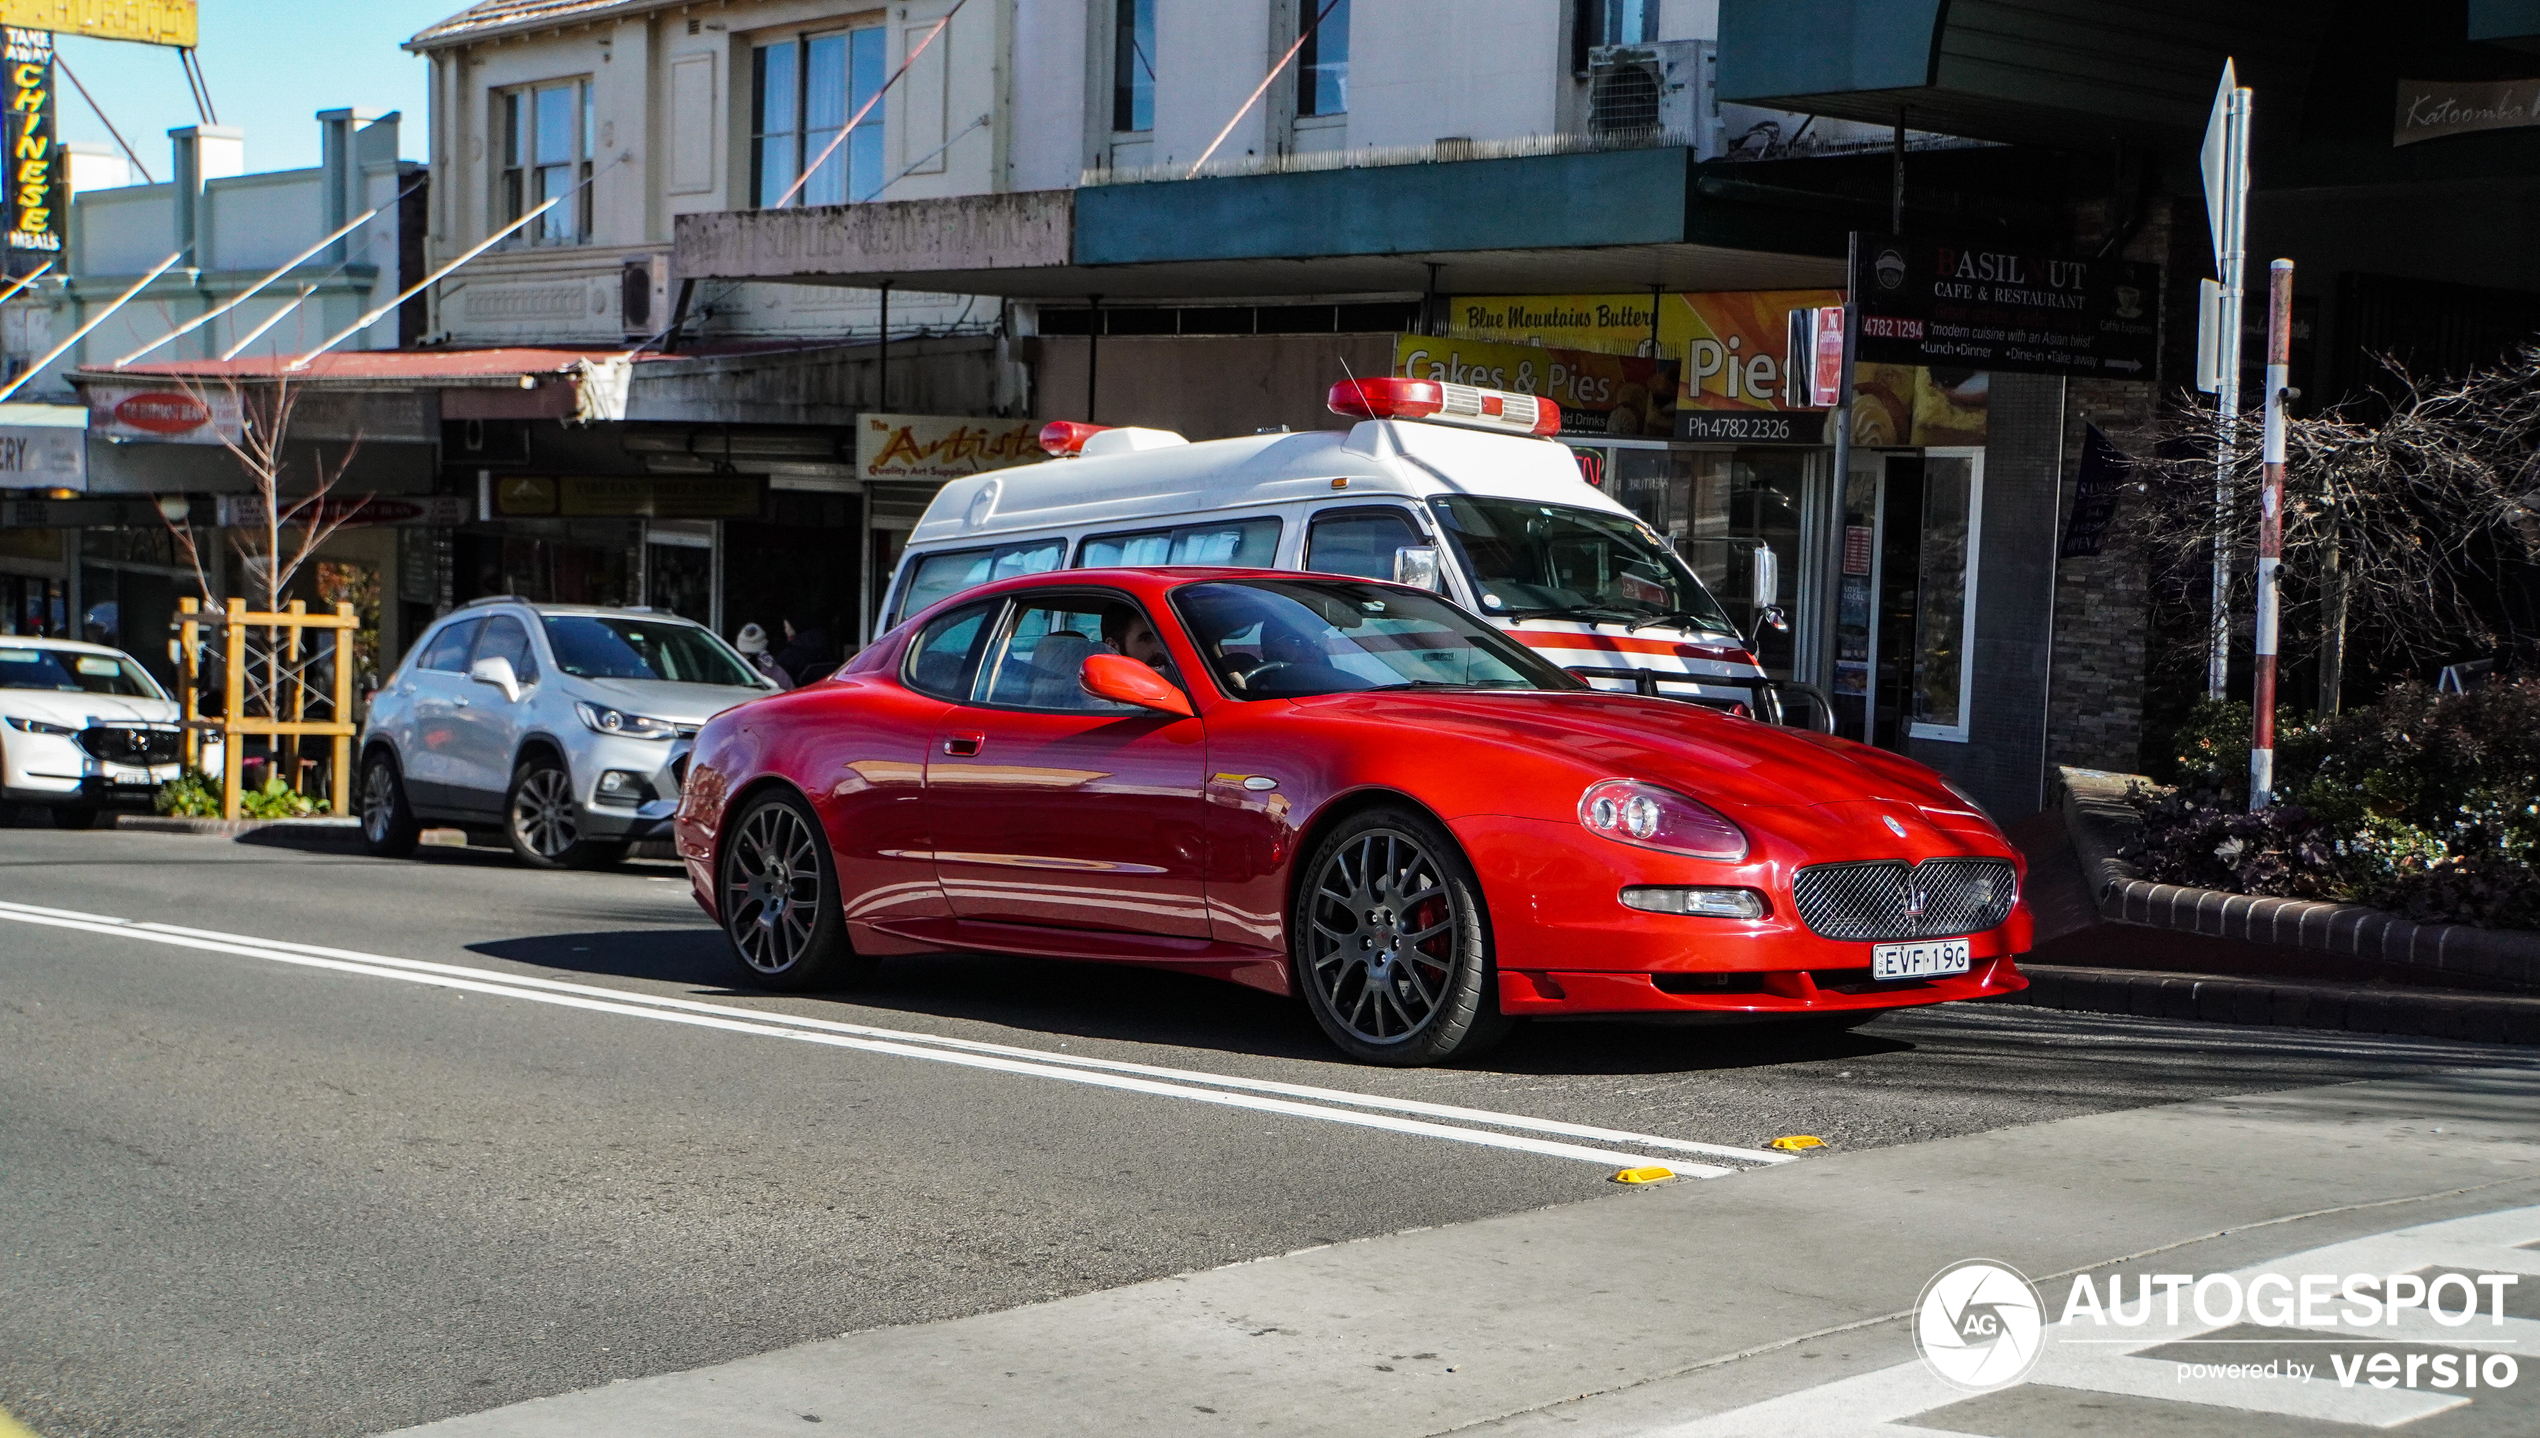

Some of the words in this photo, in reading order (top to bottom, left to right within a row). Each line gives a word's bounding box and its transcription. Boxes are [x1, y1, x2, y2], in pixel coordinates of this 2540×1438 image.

[7, 27, 52, 48] TAKE
[5, 44, 54, 65] AWAY
[2406, 89, 2523, 129] Katoomba
[14, 62, 51, 236] CHINESE
[9, 230, 61, 251] MEALS
[1934, 280, 1972, 300] CAFE
[1977, 285, 1988, 301] &
[1994, 287, 2085, 310] RESTAURANT
[1467, 306, 1503, 329] Blue
[1507, 305, 1592, 329] Mountains
[1827, 313, 1838, 329] NO
[1820, 330, 1842, 344] STOPPING
[1864, 318, 1893, 337] 4782
[1896, 320, 1923, 338] 1294
[1972, 326, 2005, 341] cuisine
[2007, 328, 2027, 343] with
[2028, 333, 2041, 344] an
[2042, 331, 2069, 347] Asian
[2073, 355, 2098, 370] away
[1513, 360, 1548, 396] &
[1548, 358, 1611, 403] Pies
[870, 419, 889, 432] The
[1575, 413, 1606, 428] Drinks
[1688, 417, 1708, 437] Ph
[1710, 418, 1748, 438] 4782
[1751, 419, 1790, 439] 2326
[867, 463, 907, 479] Quality
[910, 464, 928, 477] Art
